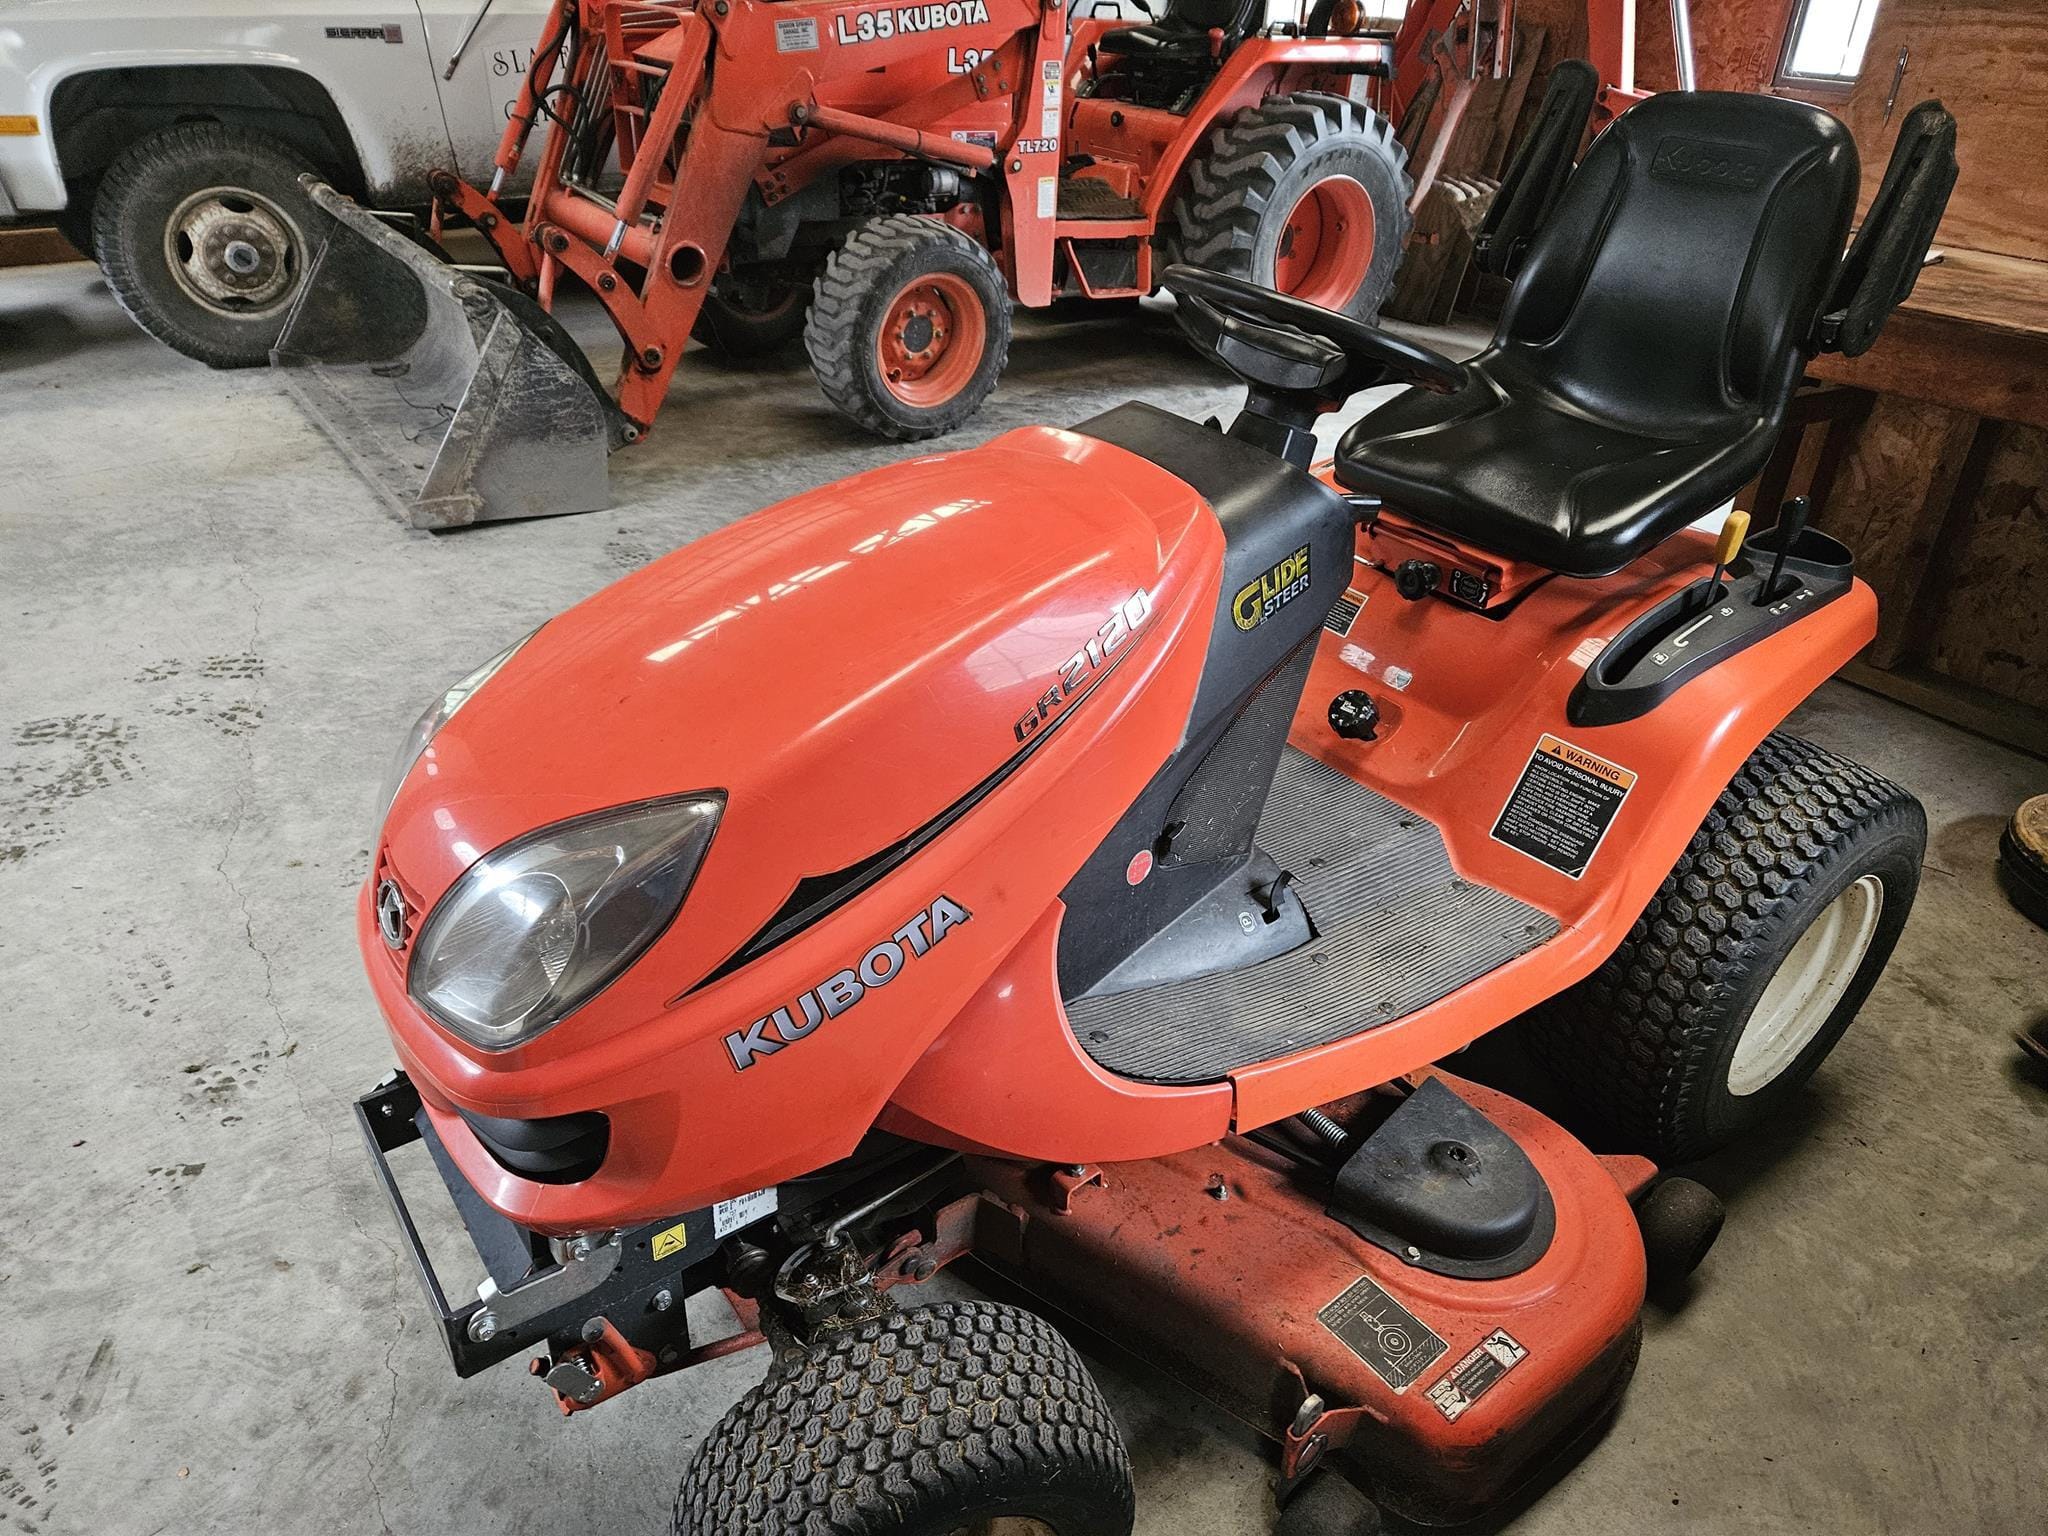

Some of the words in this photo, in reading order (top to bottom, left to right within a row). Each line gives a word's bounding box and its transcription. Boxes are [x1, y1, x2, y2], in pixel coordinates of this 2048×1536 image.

[836, 9, 895, 45] L35
[898, 0, 990, 34] KUBOTA
[1018, 138, 1057, 153] TL720
[1233, 546, 1308, 630] GLIDE
[1264, 574, 1309, 616] STEER
[1014, 587, 1152, 742] GR2120
[1535, 753, 1544, 761] TO
[1543, 758, 1564, 770] AVOID
[1564, 767, 1598, 787] PERSONAL
[1600, 783, 1624, 797] INJURY
[1566, 749, 1621, 781] WARNING
[724, 894, 972, 1070] KUBOTA
[1455, 1348, 1483, 1373] DANGER
